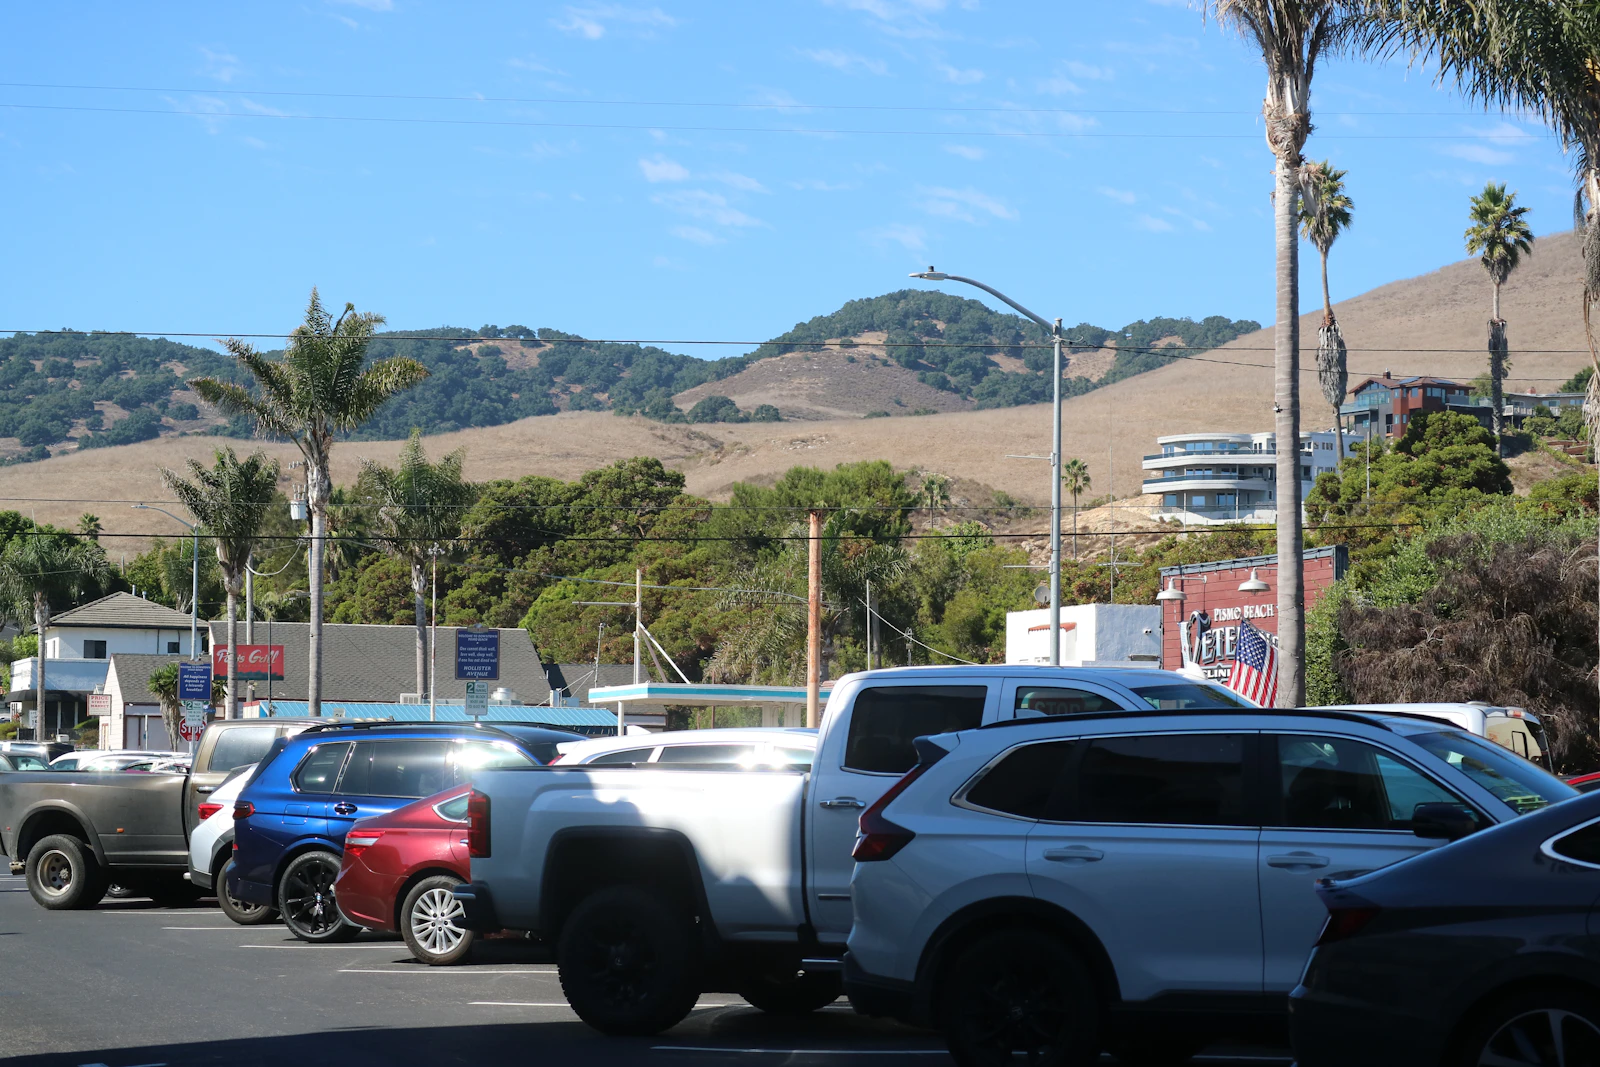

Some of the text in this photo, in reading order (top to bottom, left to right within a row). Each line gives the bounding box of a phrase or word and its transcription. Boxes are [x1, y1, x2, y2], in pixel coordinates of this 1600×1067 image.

[1214, 604, 1274, 621] PISMO BEACH
[248, 649, 279, 664] Grill
[468, 683, 474, 693] 2
